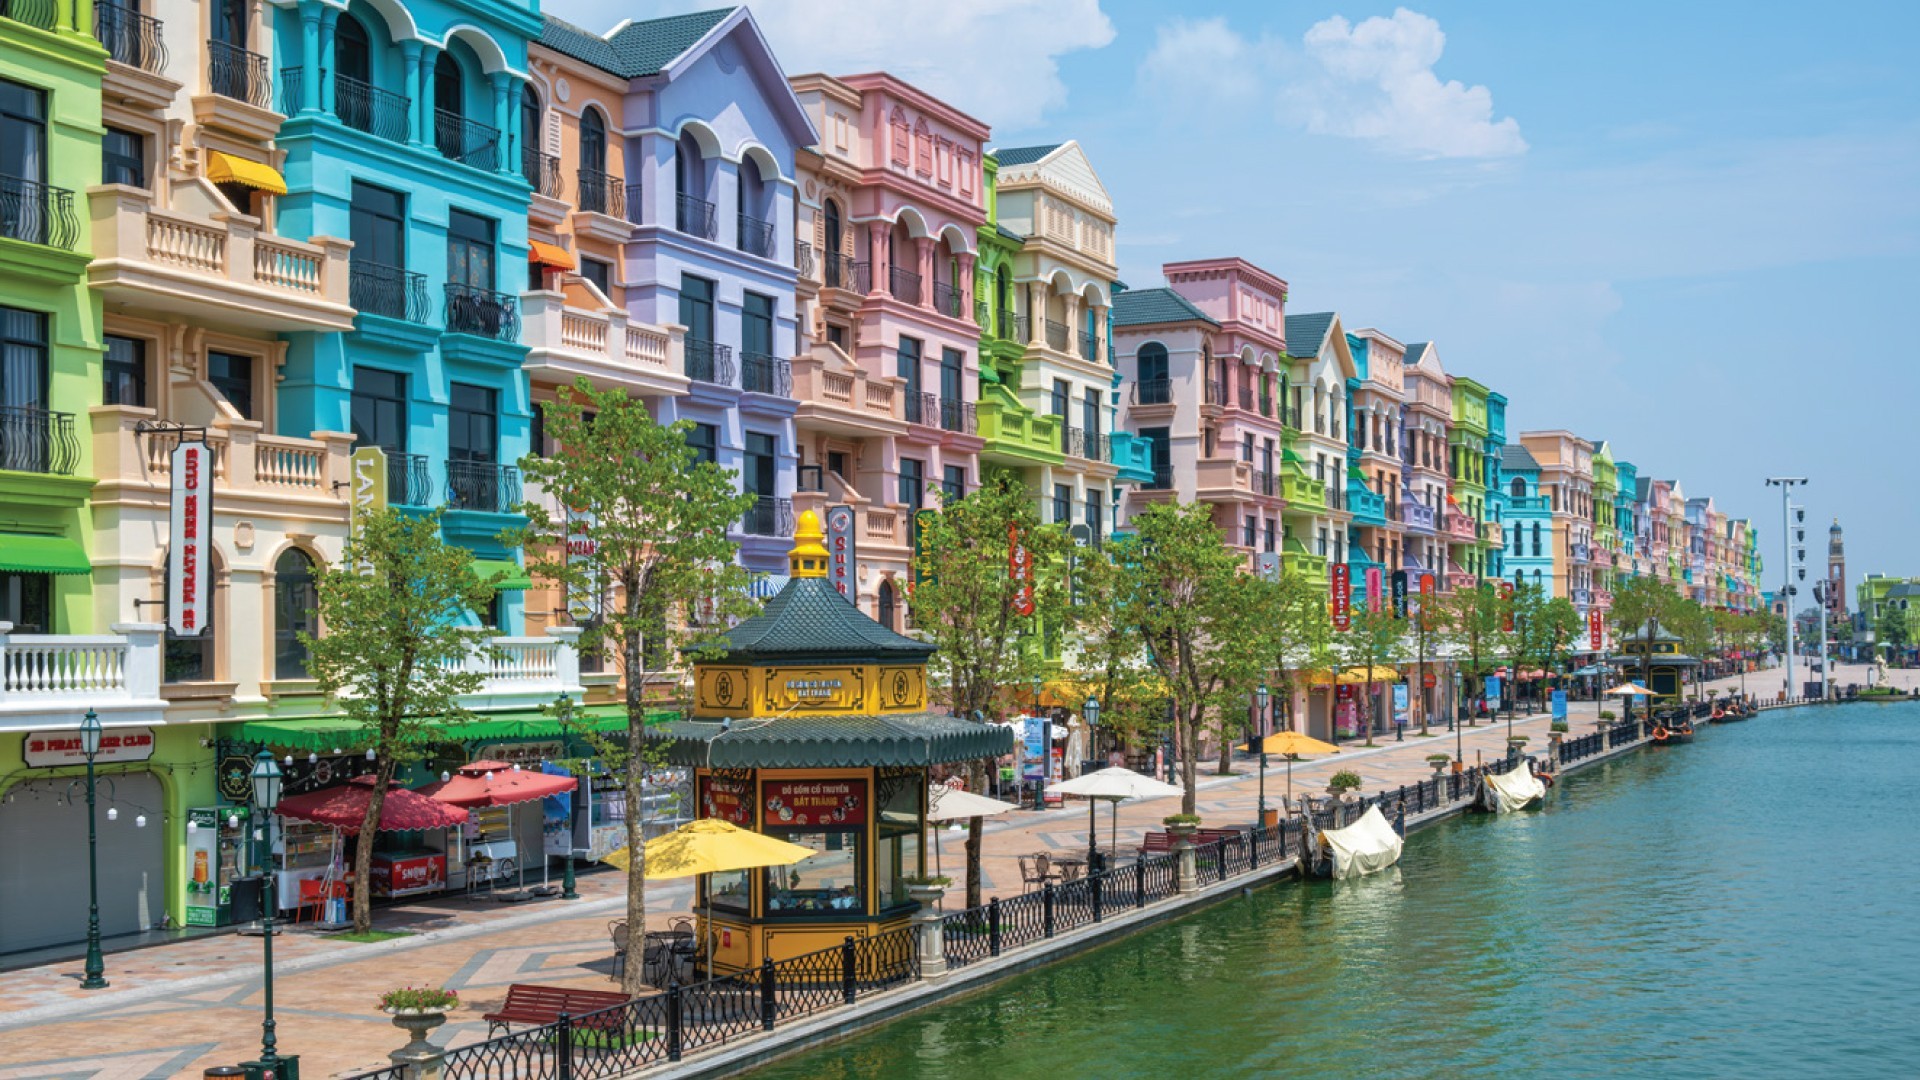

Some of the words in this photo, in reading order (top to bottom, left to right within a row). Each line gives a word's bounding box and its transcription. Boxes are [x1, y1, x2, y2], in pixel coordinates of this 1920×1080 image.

[185, 448, 199, 490] CLUB
[184, 494, 197, 540] BEER
[183, 544, 197, 604] PIRATE
[47, 738, 82, 751] PIRAT
[100, 737, 121, 748] EER
[123, 735, 152, 747] CLUB
